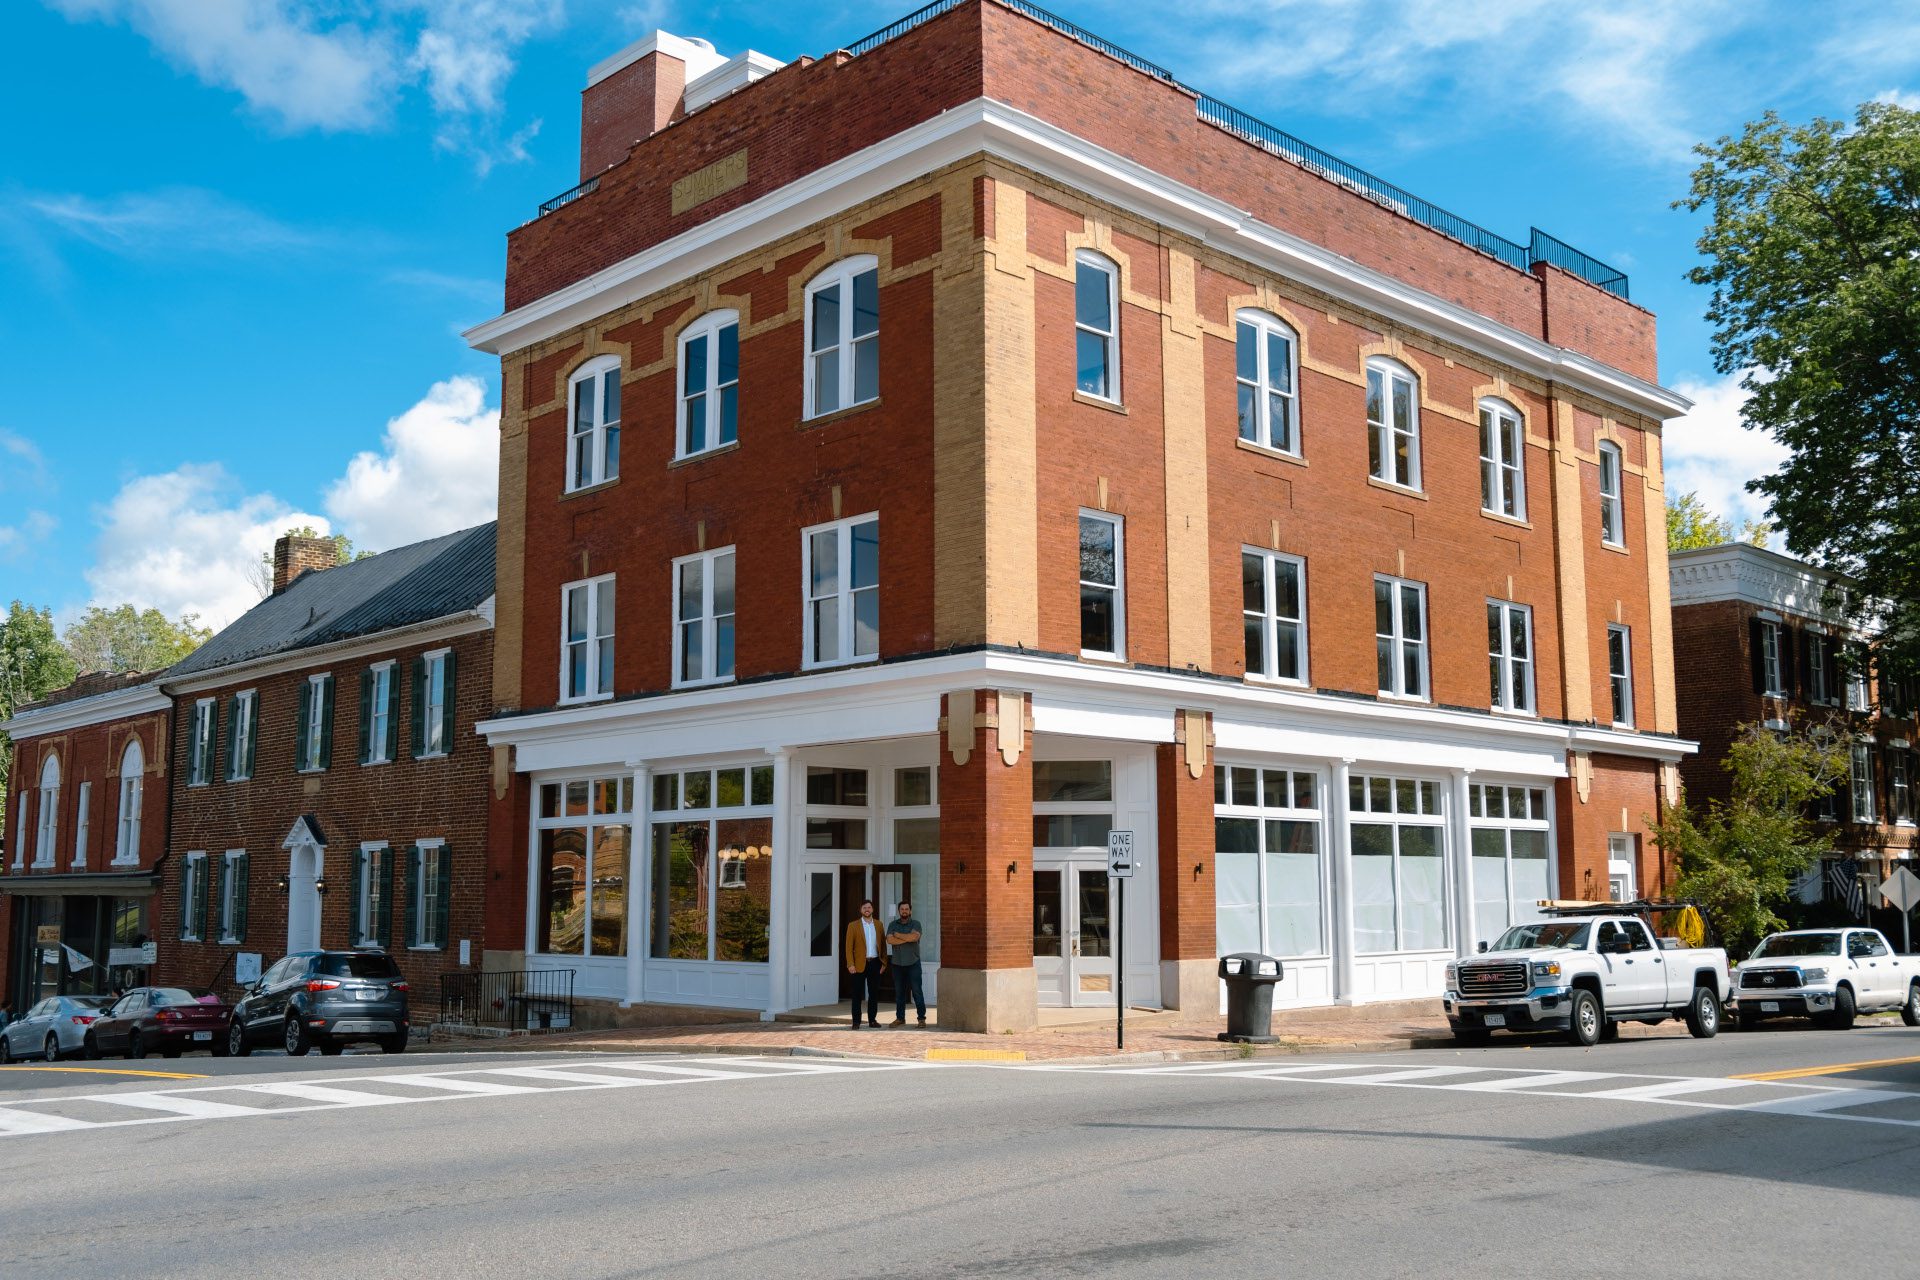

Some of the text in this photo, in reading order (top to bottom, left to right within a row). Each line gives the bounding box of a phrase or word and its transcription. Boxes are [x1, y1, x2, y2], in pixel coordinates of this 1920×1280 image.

[674, 151, 745, 198] SUMMERS
[1112, 834, 1130, 845] ONE
[1112, 847, 1130, 857] WAY
[1477, 973, 1505, 982] GMC
